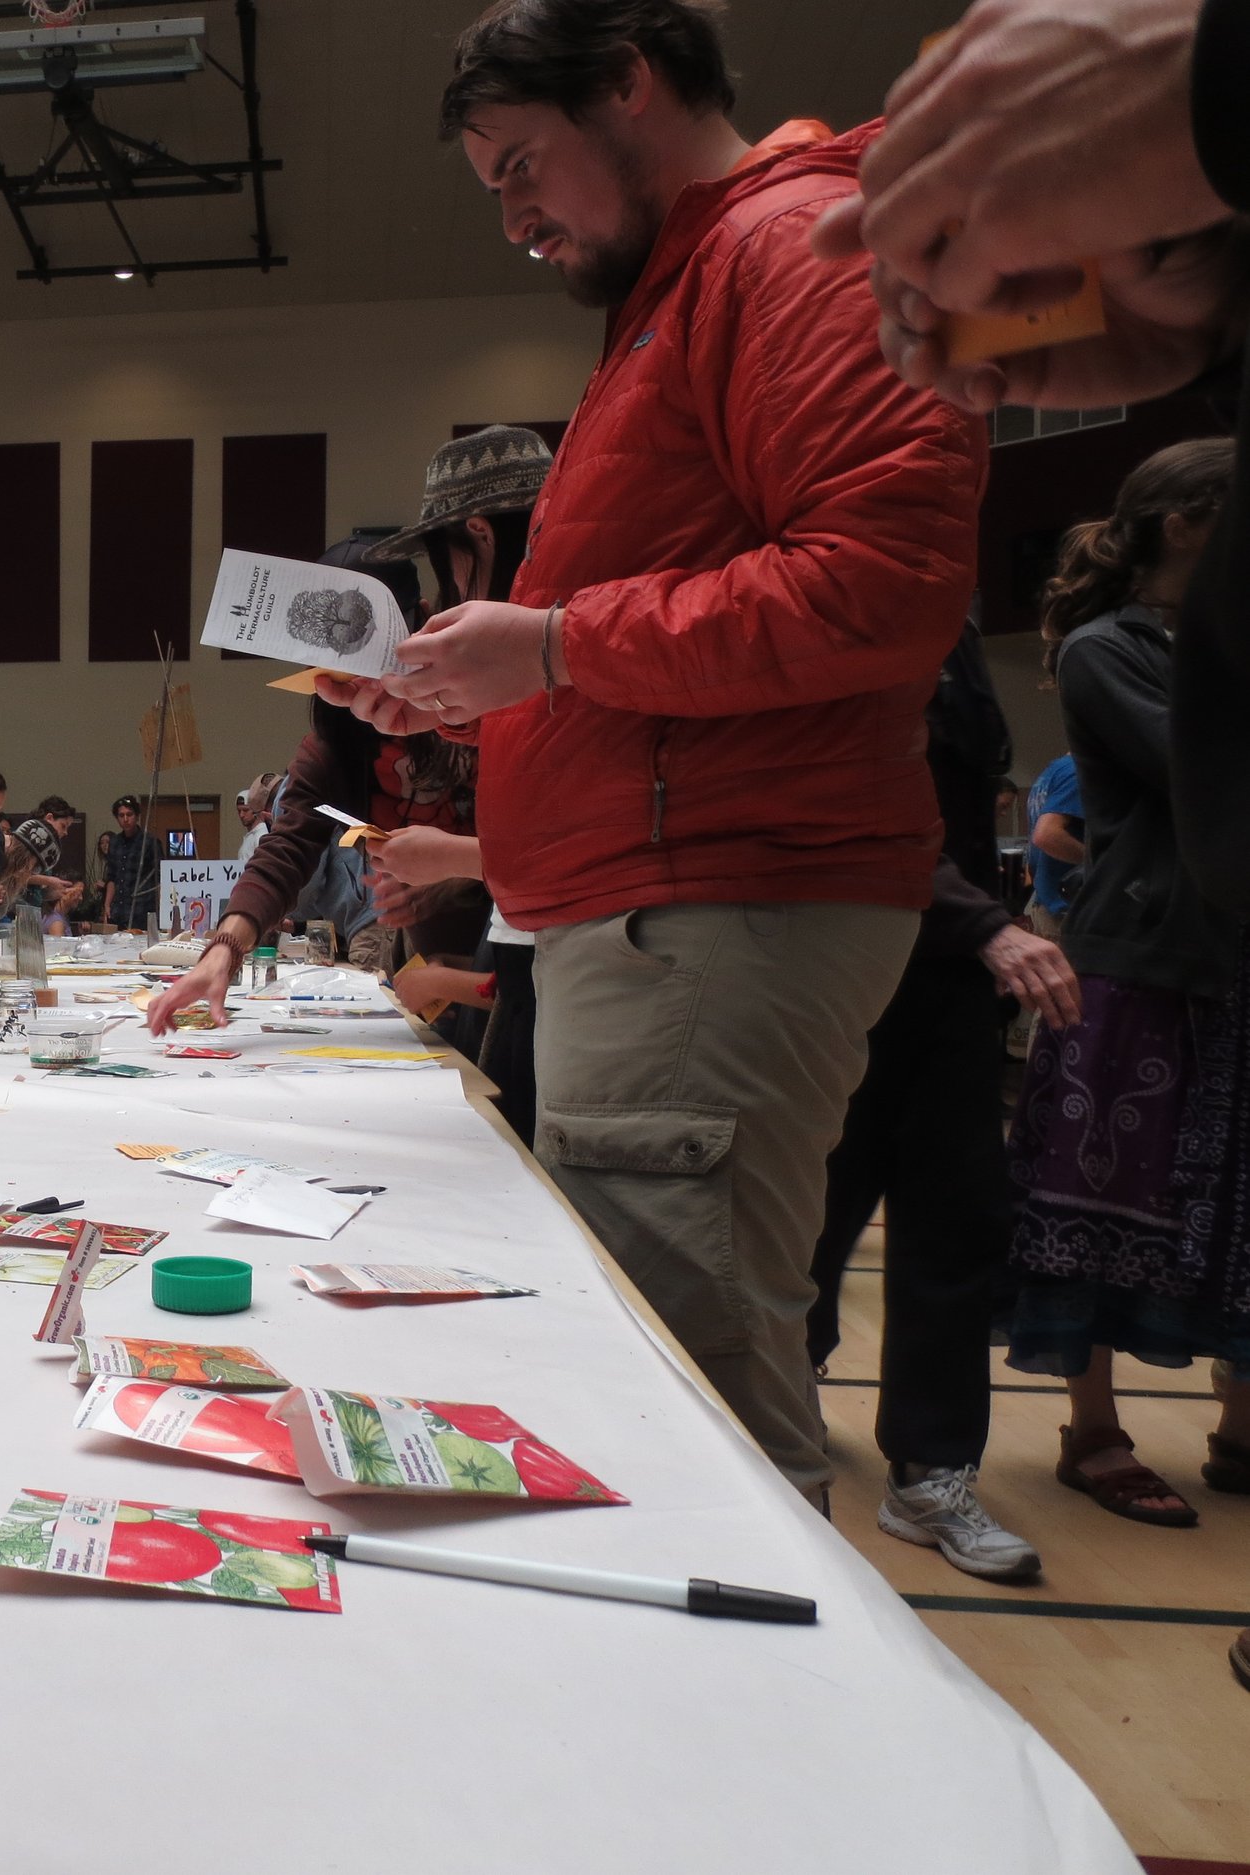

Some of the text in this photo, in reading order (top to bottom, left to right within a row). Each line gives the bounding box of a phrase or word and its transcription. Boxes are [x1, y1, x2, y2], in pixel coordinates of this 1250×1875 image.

[236, 565, 261, 640] THE HUMBOLDT
[246, 569, 271, 641] PERMACULTURE
[263, 593, 276, 622] GUILD
[47, 1284, 76, 1344] GrowOrganic.com
[400, 1453, 417, 1483] Tomato
